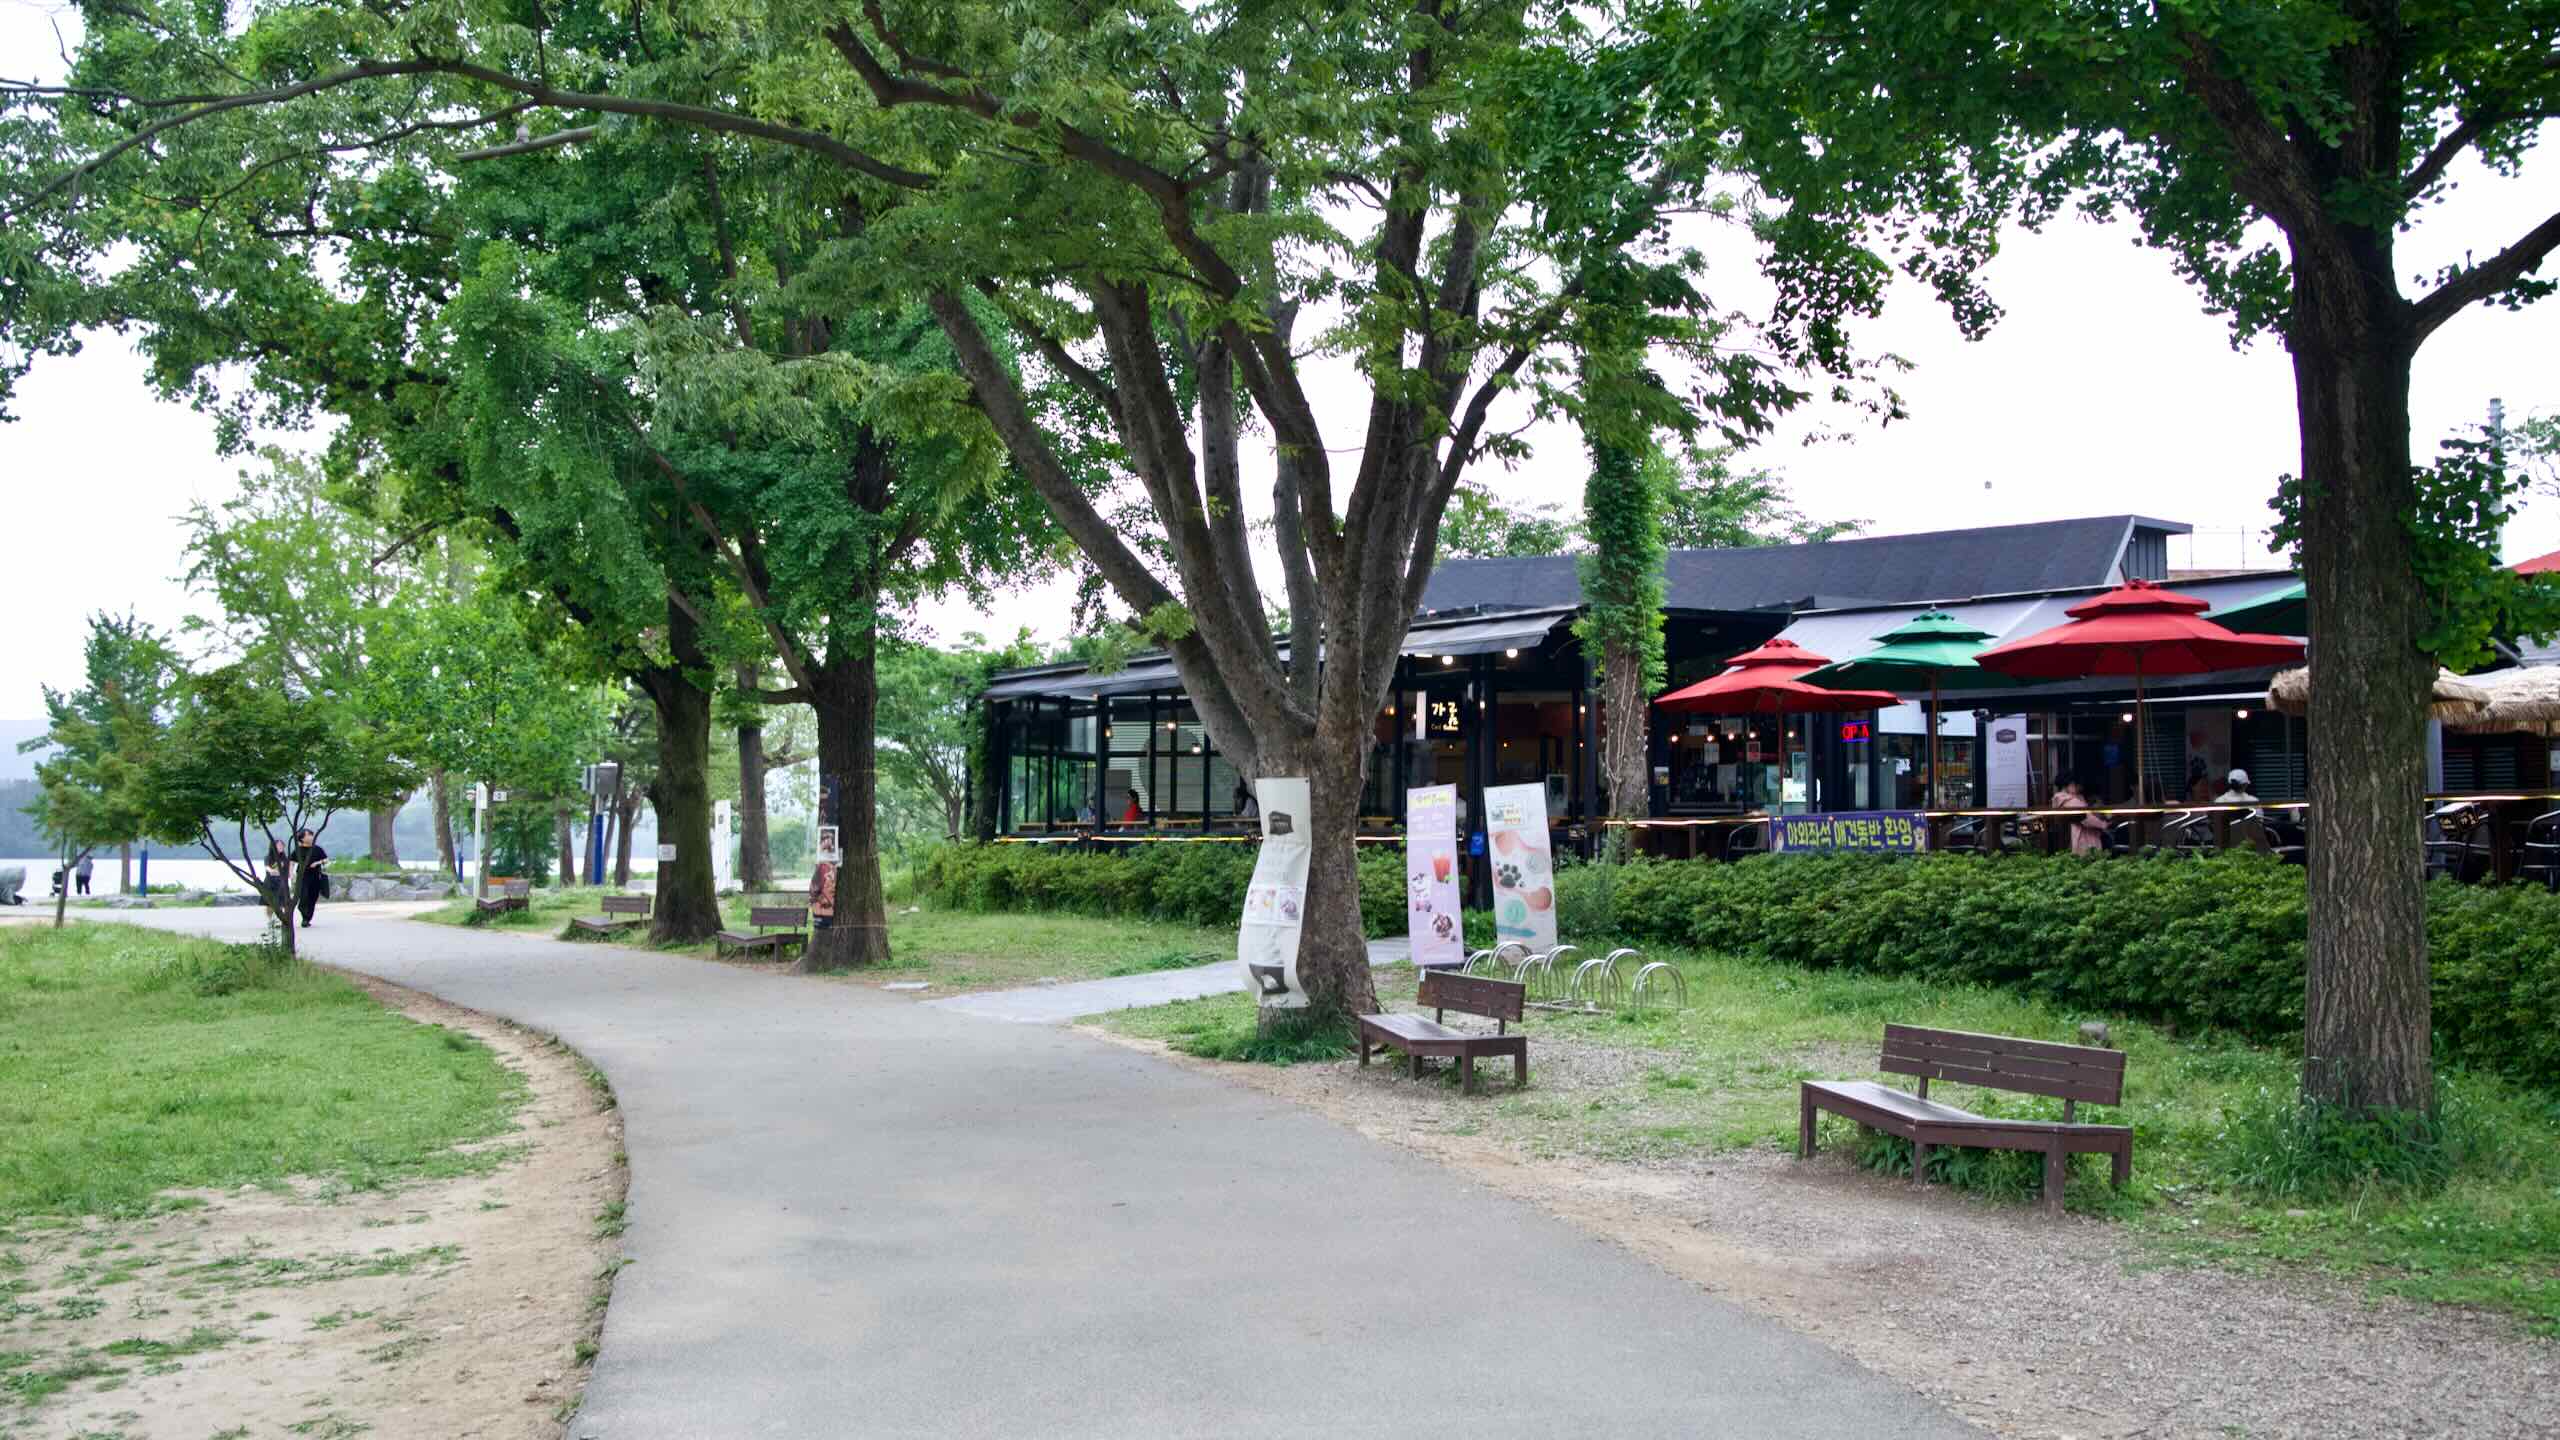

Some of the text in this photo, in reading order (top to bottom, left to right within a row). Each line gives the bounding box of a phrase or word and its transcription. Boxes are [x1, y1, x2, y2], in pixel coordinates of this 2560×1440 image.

[1842, 726, 1869, 739] OPN
[1787, 816, 1912, 847] 야외좌석 애견동반 환영
